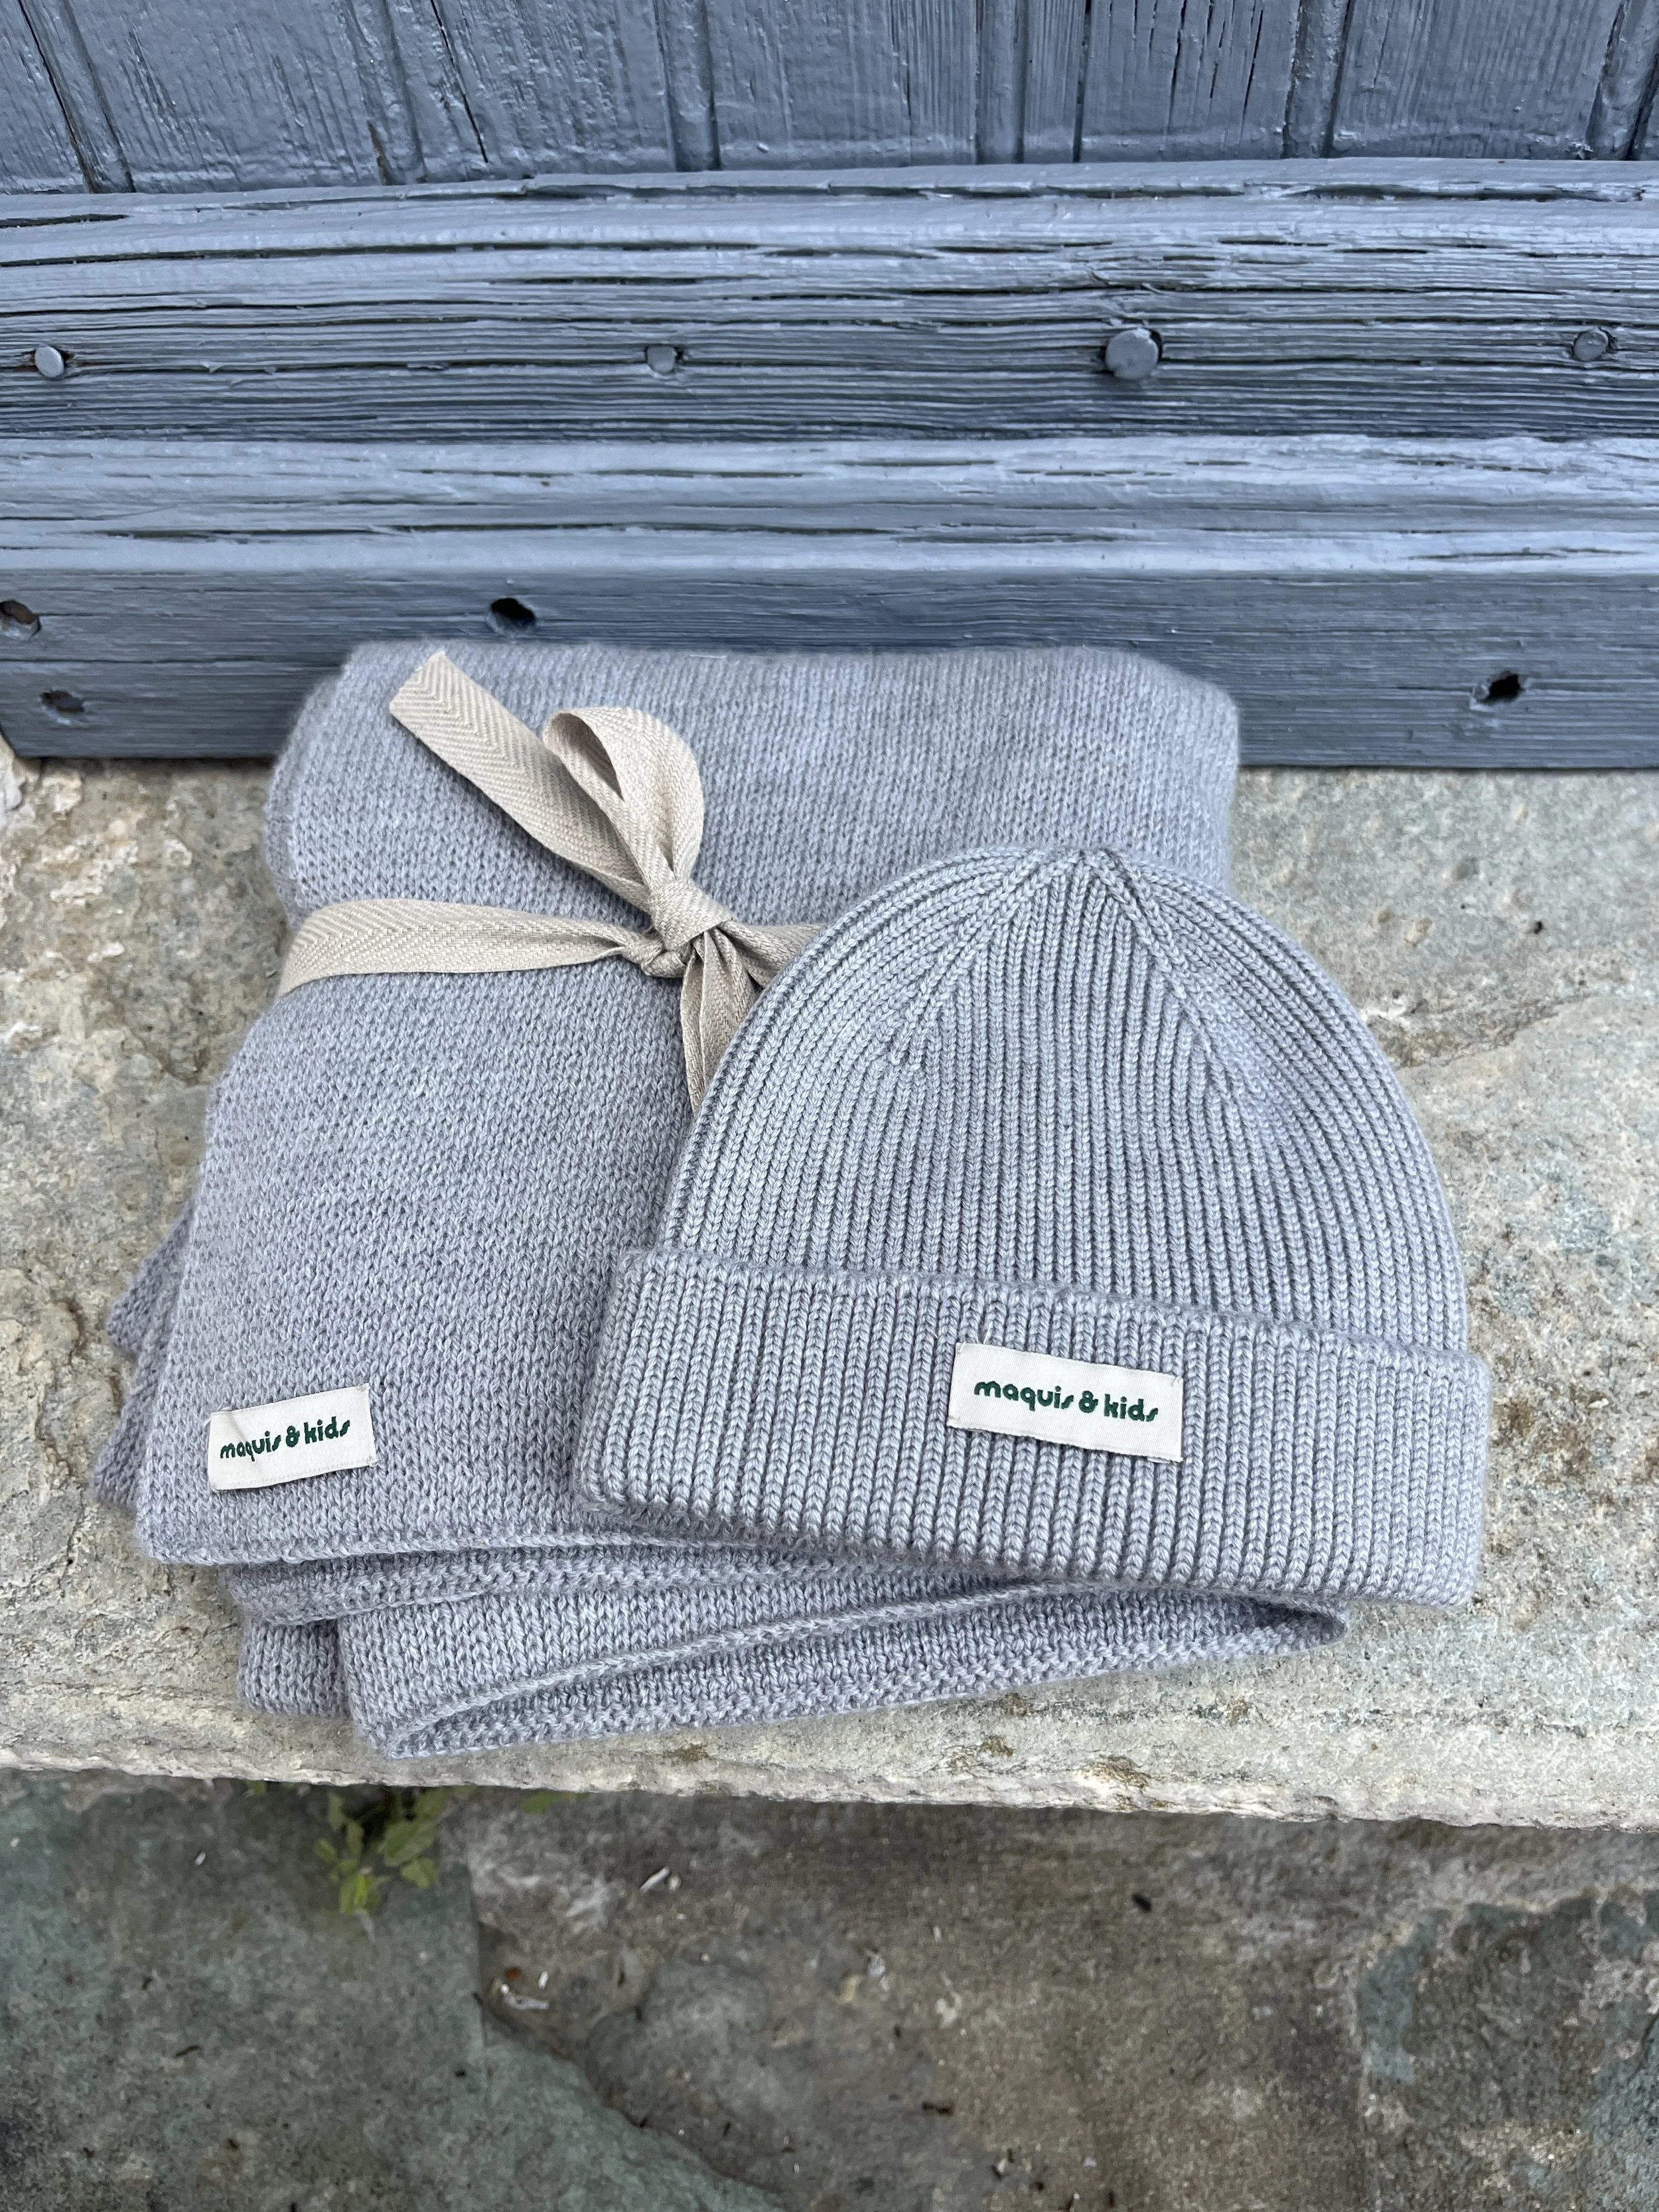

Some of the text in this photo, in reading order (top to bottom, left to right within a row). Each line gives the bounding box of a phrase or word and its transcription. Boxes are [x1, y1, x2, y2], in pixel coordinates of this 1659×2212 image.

[974, 1380, 1159, 1422] maquis & kids
[220, 1416, 350, 1461] maquis & kids
